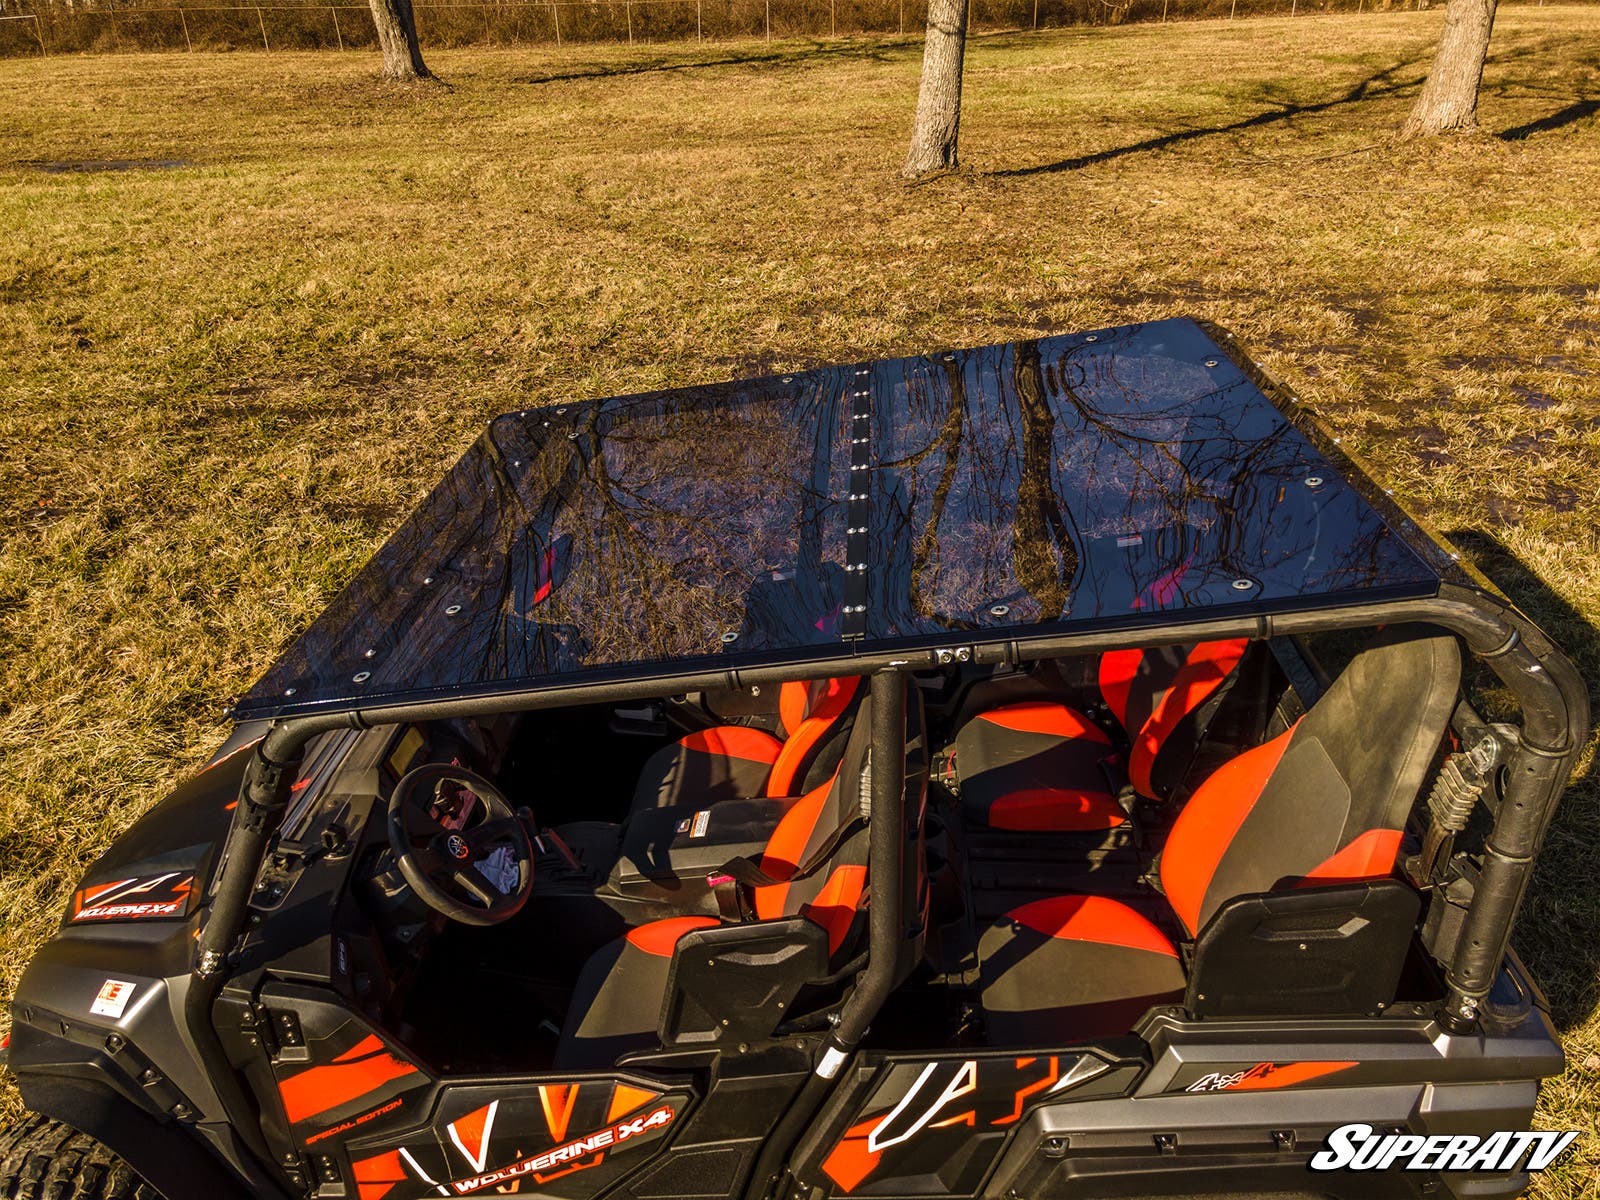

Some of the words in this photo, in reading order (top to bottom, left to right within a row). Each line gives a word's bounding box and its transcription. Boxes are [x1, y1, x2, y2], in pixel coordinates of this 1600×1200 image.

[149, 904, 177, 913] X4
[305, 1122, 356, 1145] SPECIAL
[356, 1098, 403, 1125] EDITION
[454, 1129, 615, 1193] WOLVERINE
[618, 1108, 673, 1140] X4
